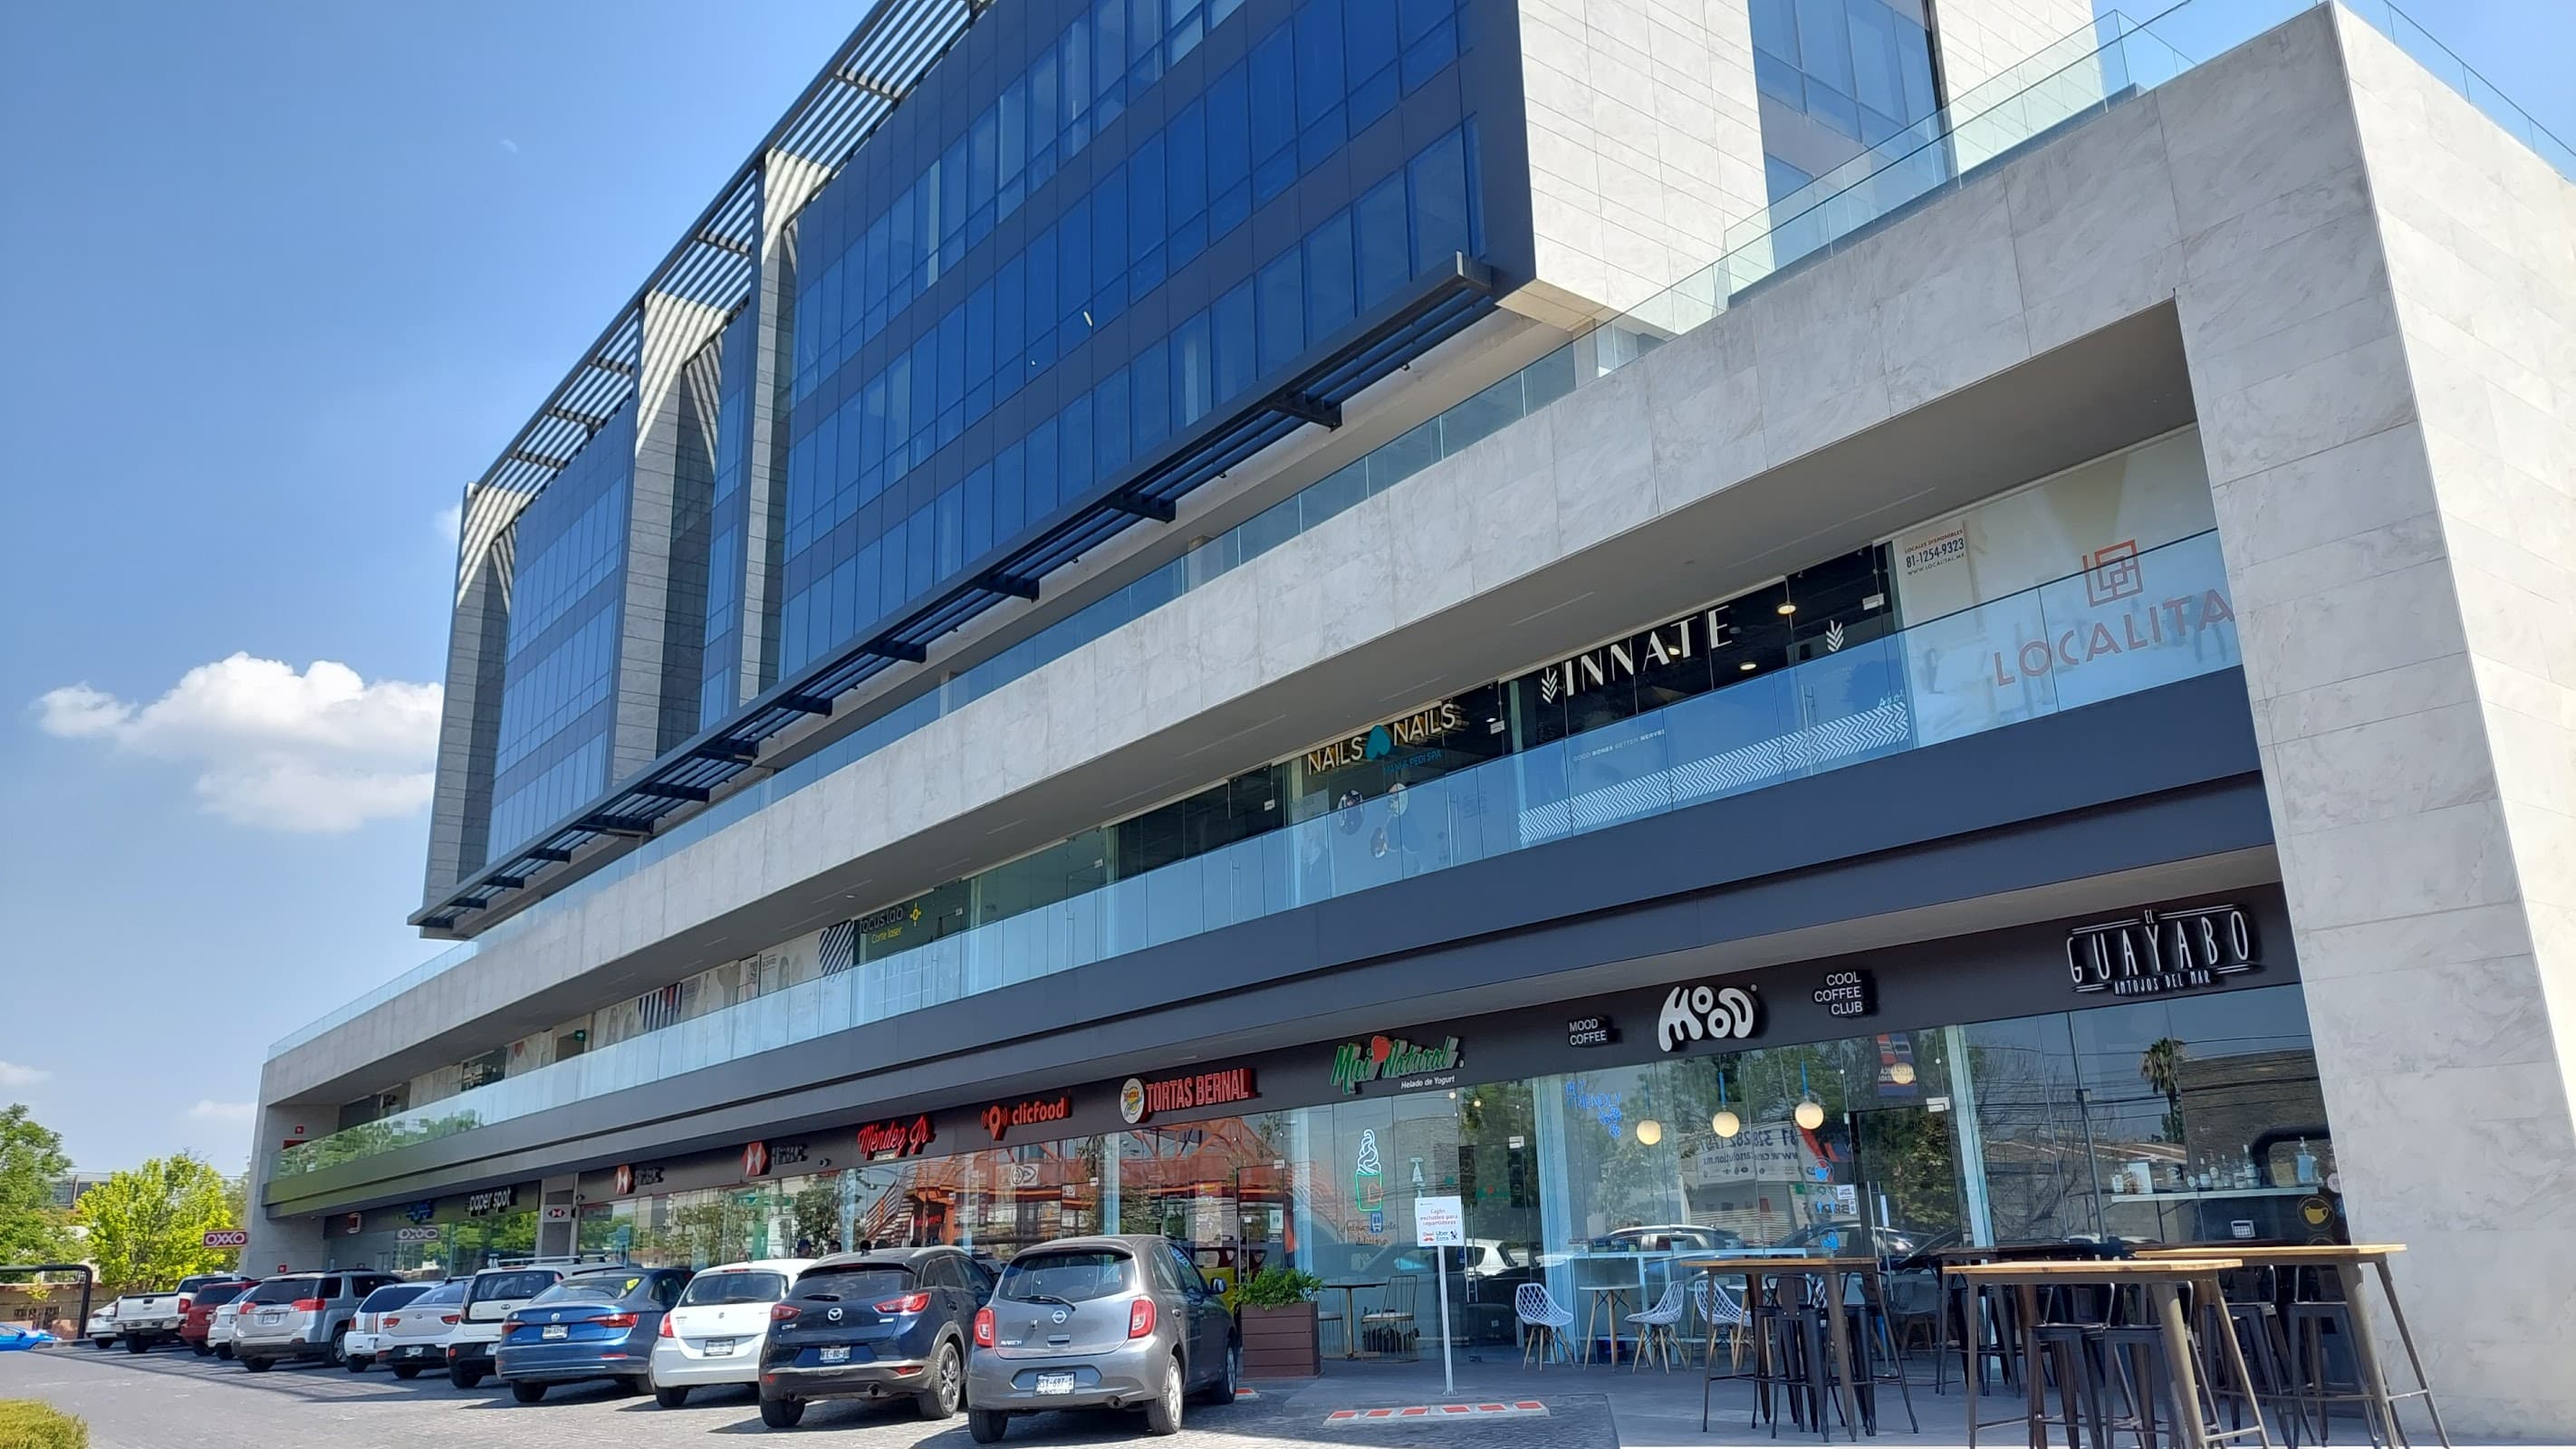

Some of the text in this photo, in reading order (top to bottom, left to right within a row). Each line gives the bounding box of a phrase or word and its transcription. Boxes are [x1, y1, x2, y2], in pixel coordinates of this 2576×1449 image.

[1906, 537, 1965, 568] 81-1254-9323
[1564, 605, 1733, 696] INNATE
[1307, 703, 1456, 776] NAILS NAILS
[1427, 749, 1443, 762] SPA
[2144, 909, 2155, 925] EL
[2066, 911, 2249, 984] GUAYABO
[1826, 972, 1861, 987] COOL
[2114, 969, 2211, 994] ANTOJOS DEL MAR
[1814, 986, 1862, 1003] COFFEE
[1658, 985, 1754, 1052] MOOD
[1831, 1002, 1863, 1016] CLUB
[1569, 1018, 1599, 1033] MOOD
[1570, 1031, 1608, 1046] COFFEE
[1381, 1035, 1455, 1079] Natural
[1145, 1068, 1249, 1113] TORTAS BERNAL
[1400, 1075, 1456, 1089] Helado de Yogurt
[1012, 1097, 1066, 1126] clicfood
[468, 1186, 512, 1217] paper spot
[205, 1232, 245, 1245] OXXO
